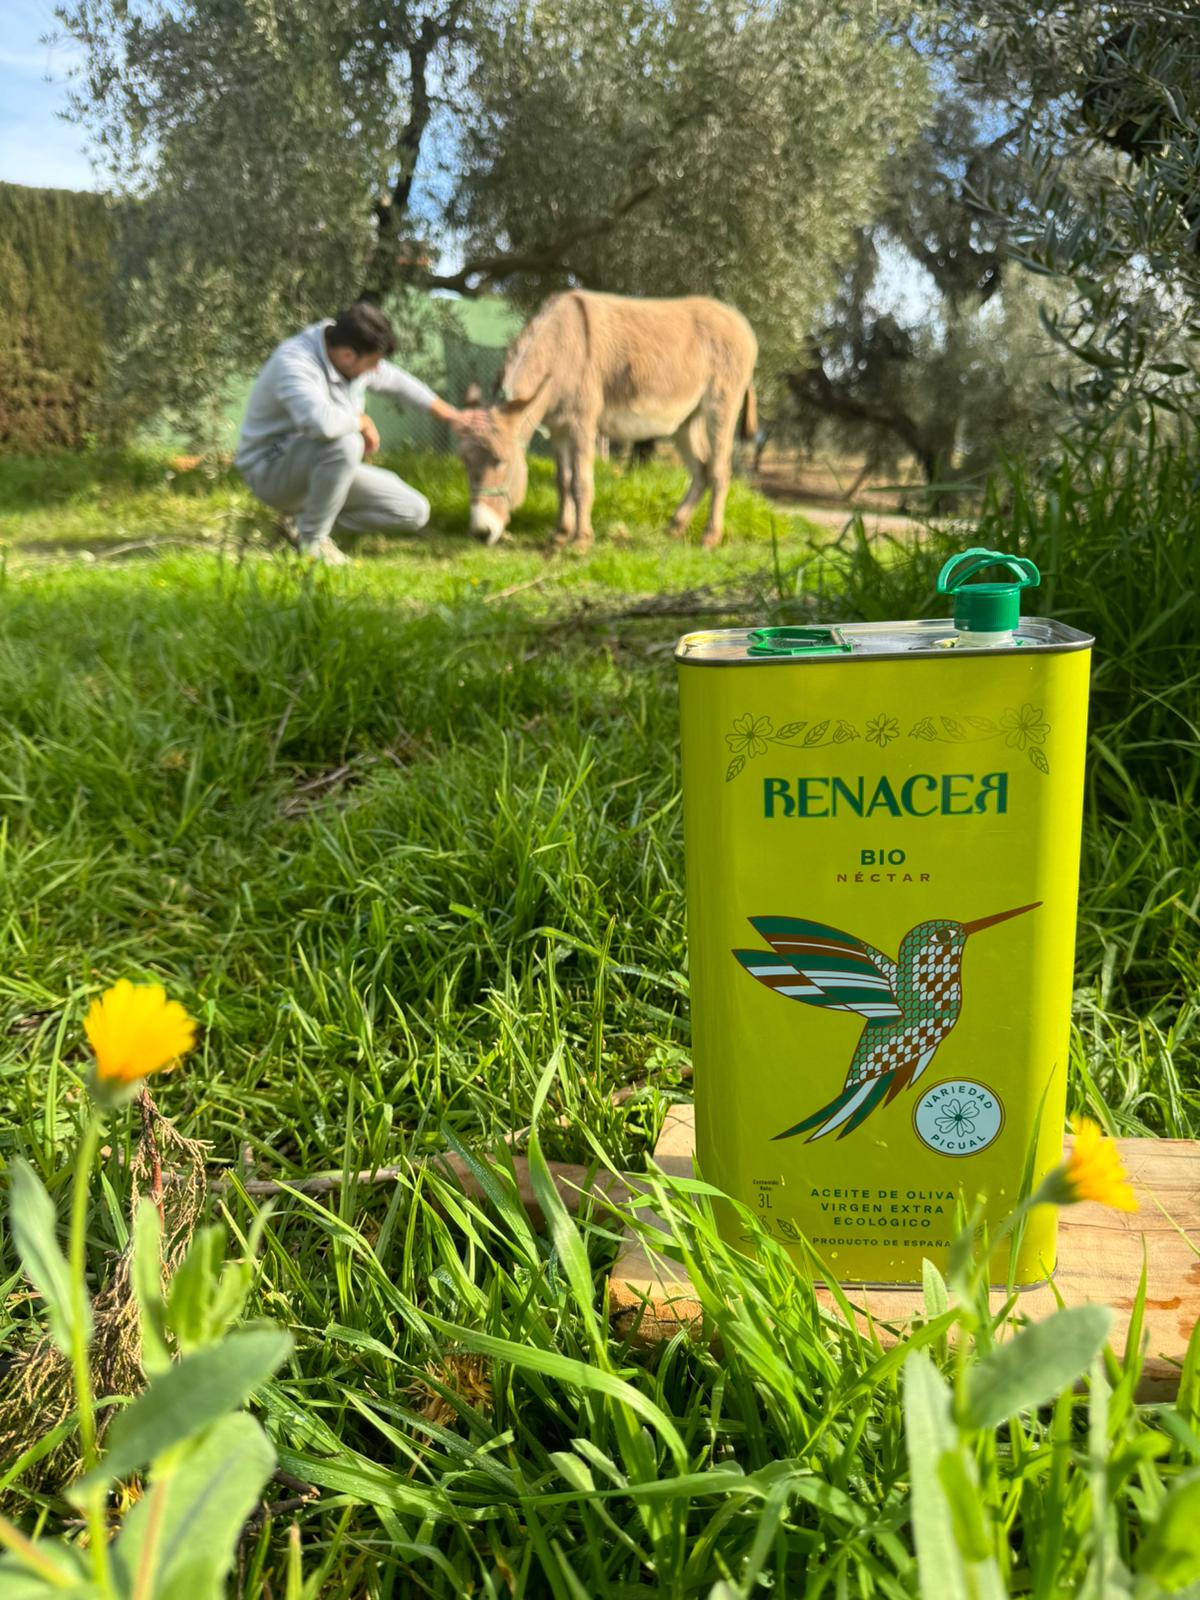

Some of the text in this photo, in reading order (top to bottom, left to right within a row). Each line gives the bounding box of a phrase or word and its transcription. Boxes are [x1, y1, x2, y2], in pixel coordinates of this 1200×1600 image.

[763, 772, 1008, 818] RENACER
[860, 849, 906, 866] BIO
[836, 871, 931, 883] NÉCTAR
[924, 1085, 993, 1110] VARIEDAD
[930, 1133, 987, 1150] PICUAL
[758, 1193, 773, 1208] 3L
[810, 1188, 955, 1200] ACEITE DE OLIVA
[821, 1203, 944, 1214] VIRGEN EXTRA
[833, 1216, 931, 1227] ECOLÓGICO
[812, 1237, 951, 1247] PRODUCTO DE ESPAÑA
